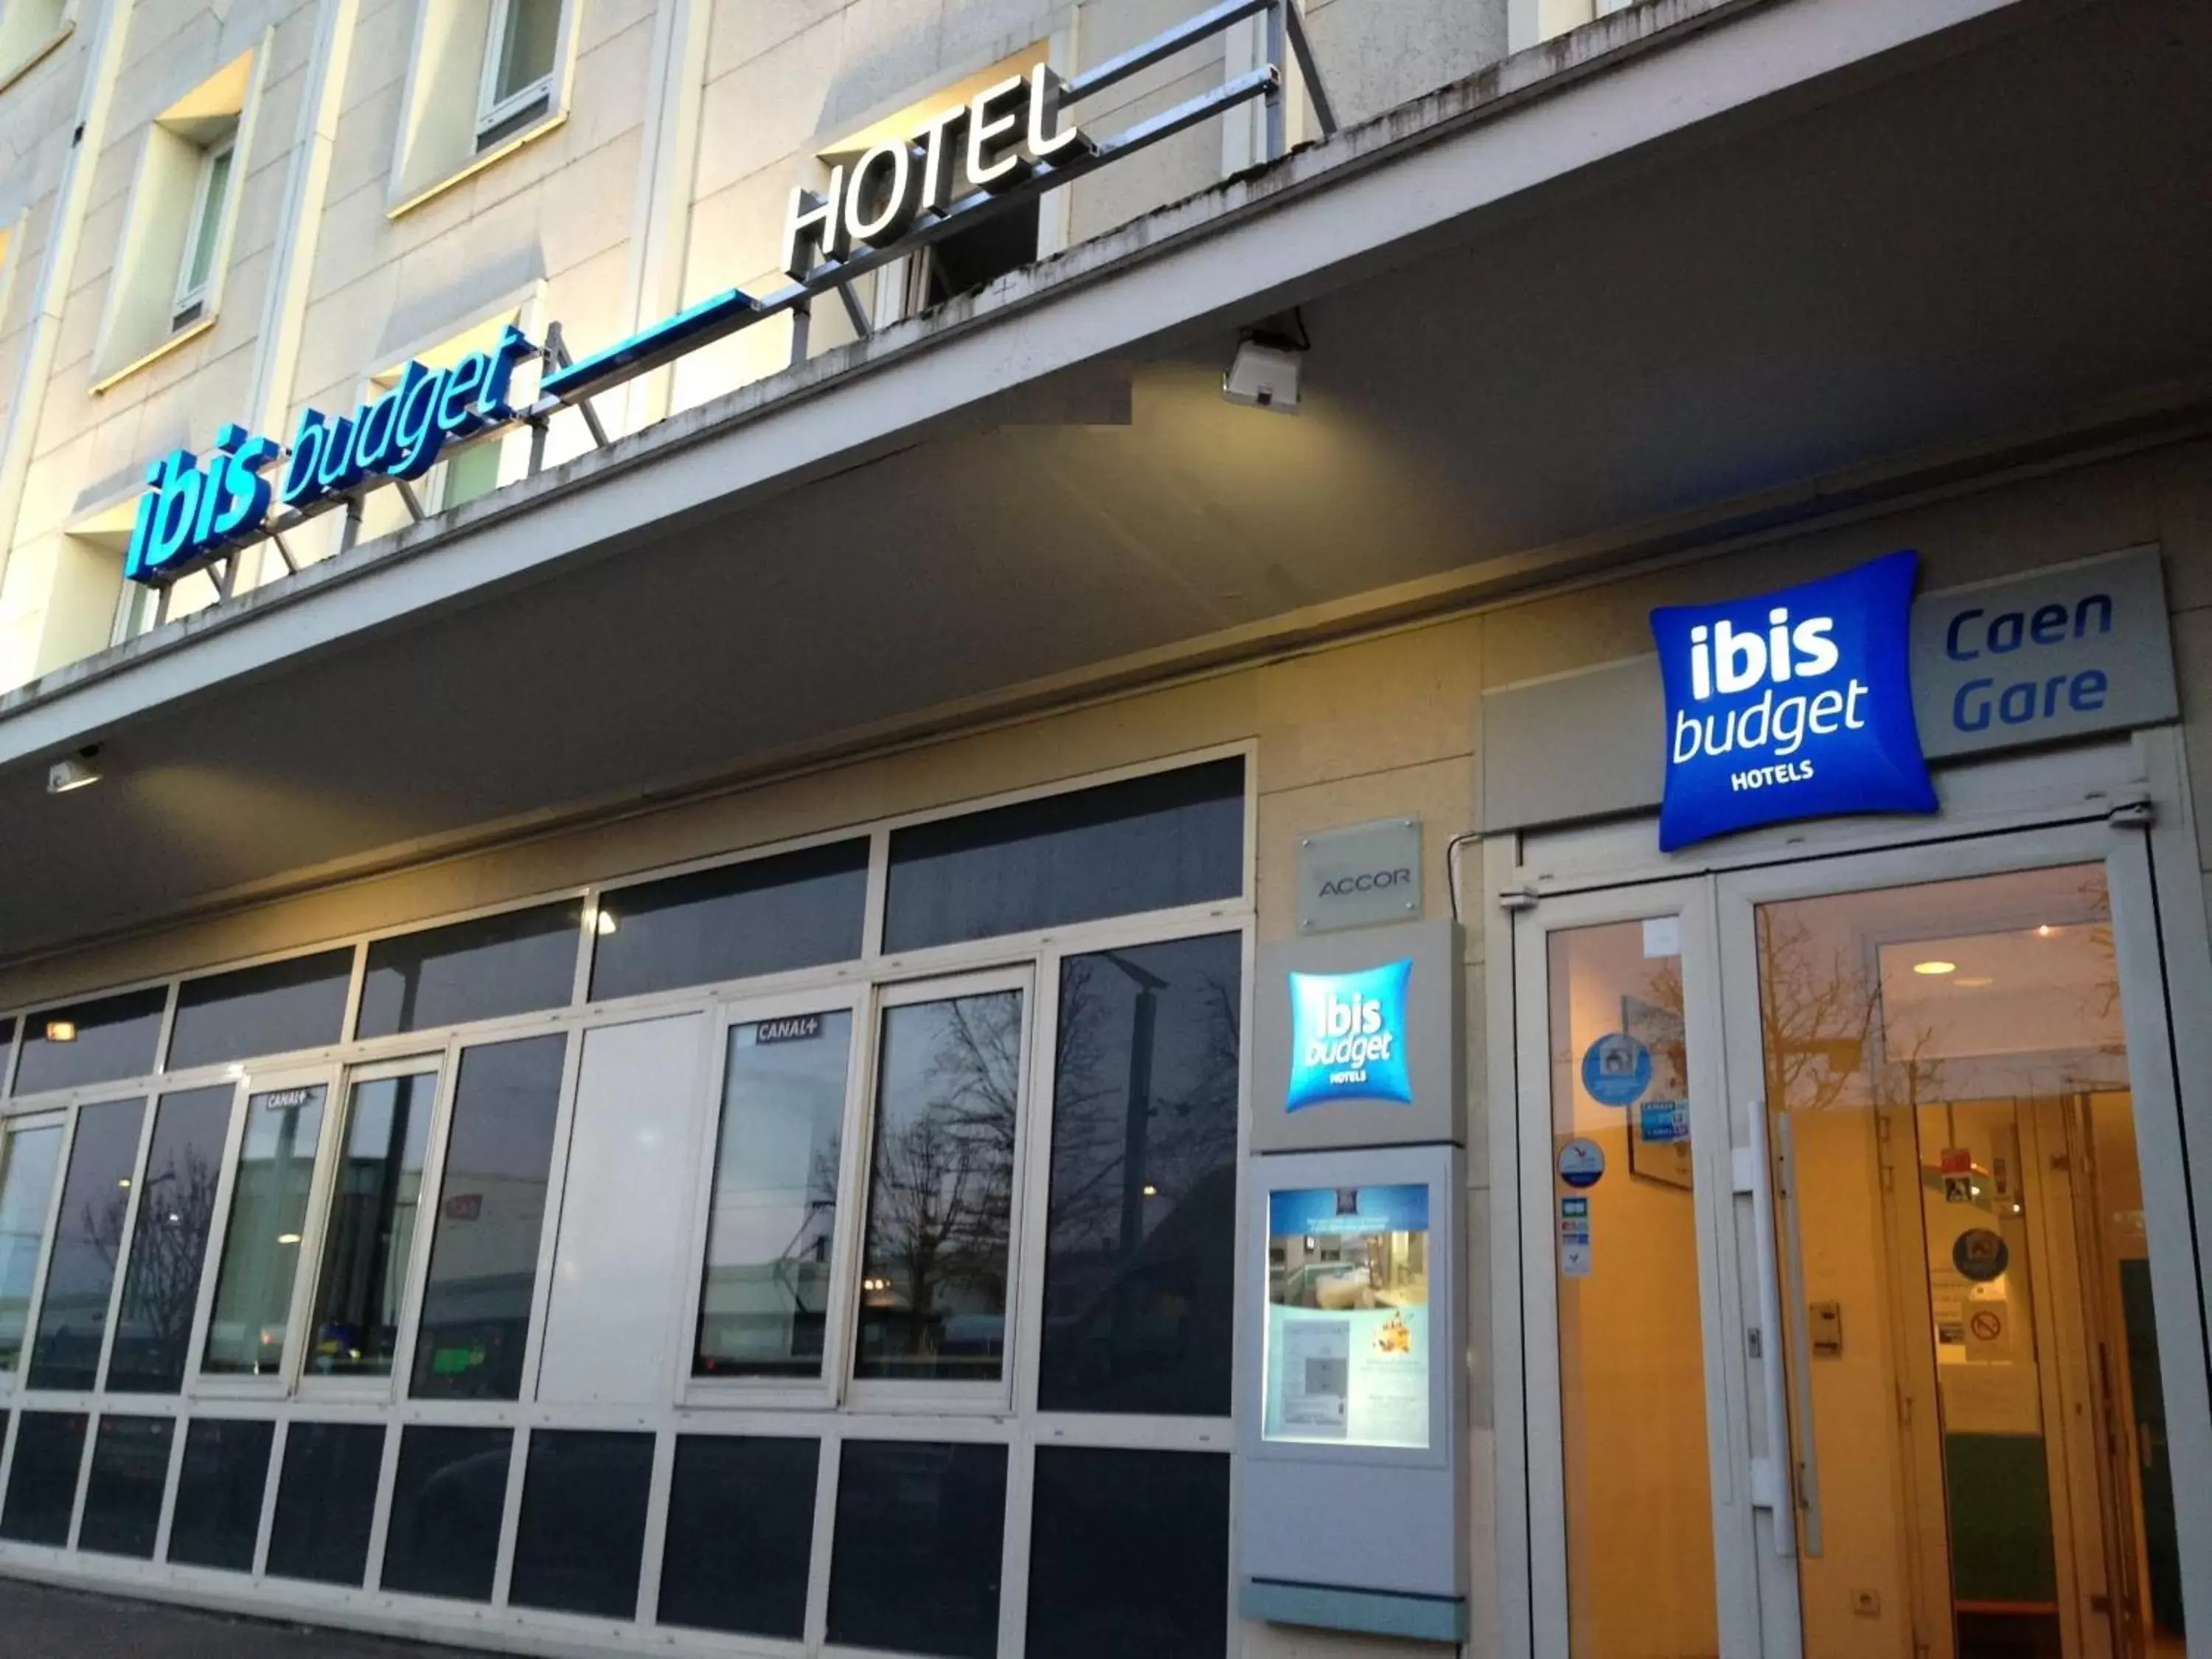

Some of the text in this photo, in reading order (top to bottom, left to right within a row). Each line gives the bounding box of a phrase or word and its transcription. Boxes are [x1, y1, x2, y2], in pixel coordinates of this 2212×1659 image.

[125, 62, 1085, 582] ibis budget HOTEL
[1946, 594, 2112, 662] Caen
[1690, 607, 1839, 701] ibis
[1672, 679, 1868, 764] budget
[1952, 669, 2109, 733] Gare
[1731, 759, 1814, 792] HOTELS
[1318, 867, 1411, 897] ACCOR
[759, 1017, 818, 1041] CANAL+
[1316, 992, 1382, 1038] ibis
[1304, 1030, 1393, 1068] budget
[1329, 1070, 1367, 1084] HOTELS
